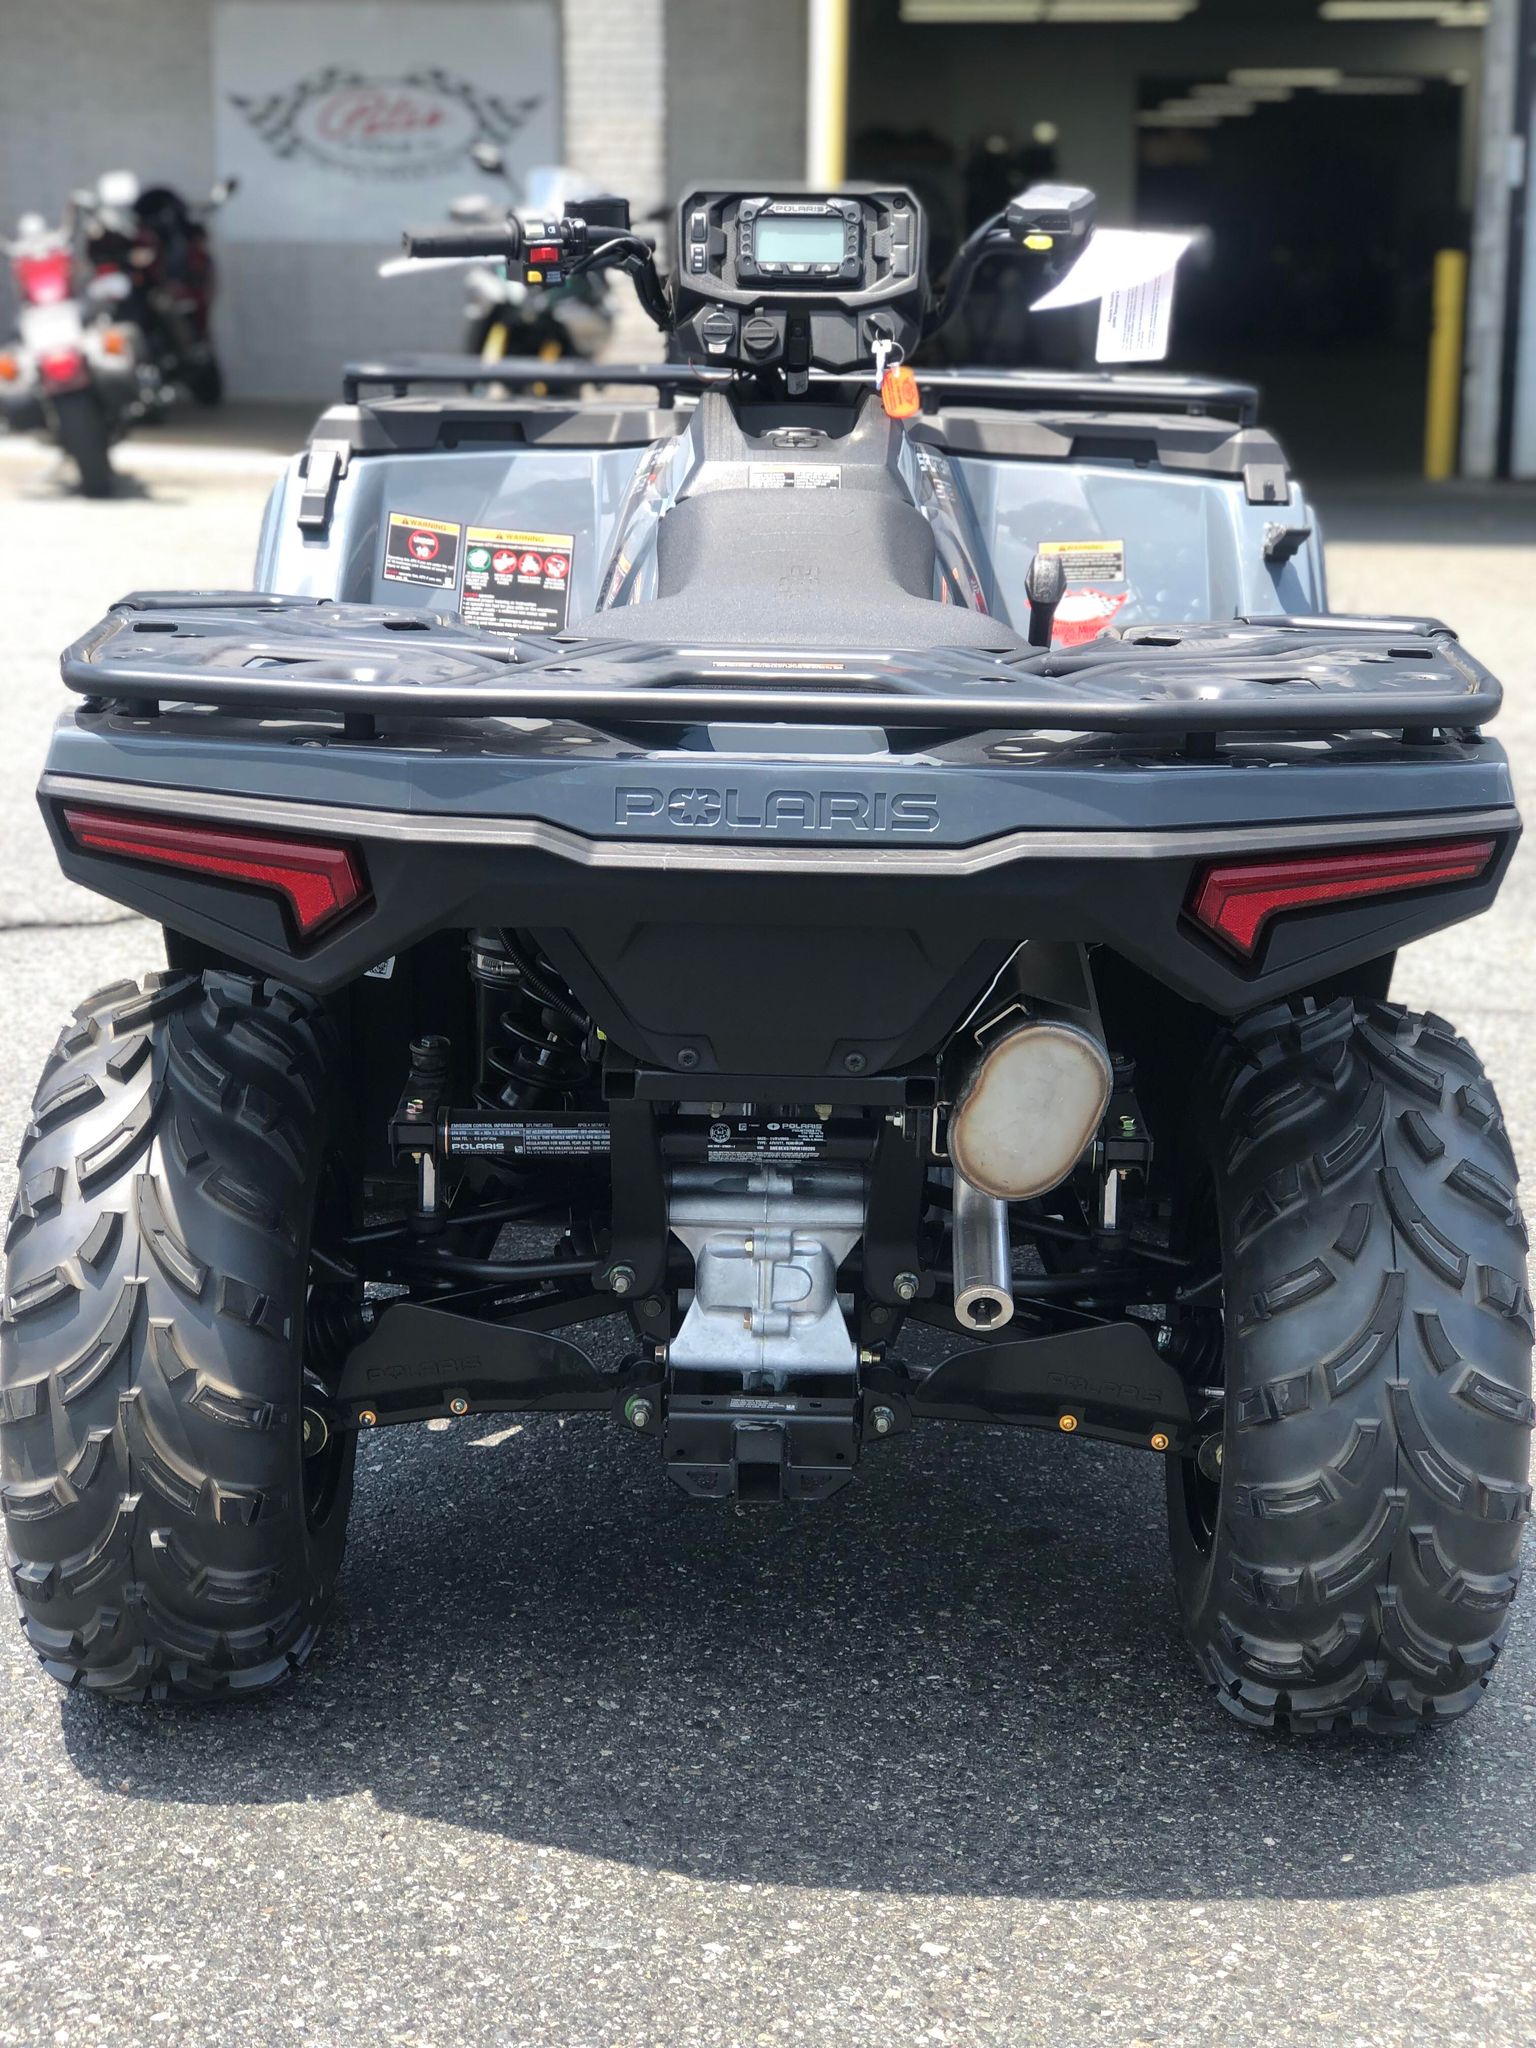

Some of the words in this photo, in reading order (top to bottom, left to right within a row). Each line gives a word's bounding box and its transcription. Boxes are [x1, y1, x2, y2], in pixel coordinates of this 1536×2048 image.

[410, 519, 447, 531] WARNING
[506, 534, 544, 542] WARNING
[615, 787, 941, 832] POLARIS
[367, 1356, 481, 1382] POLARIS
